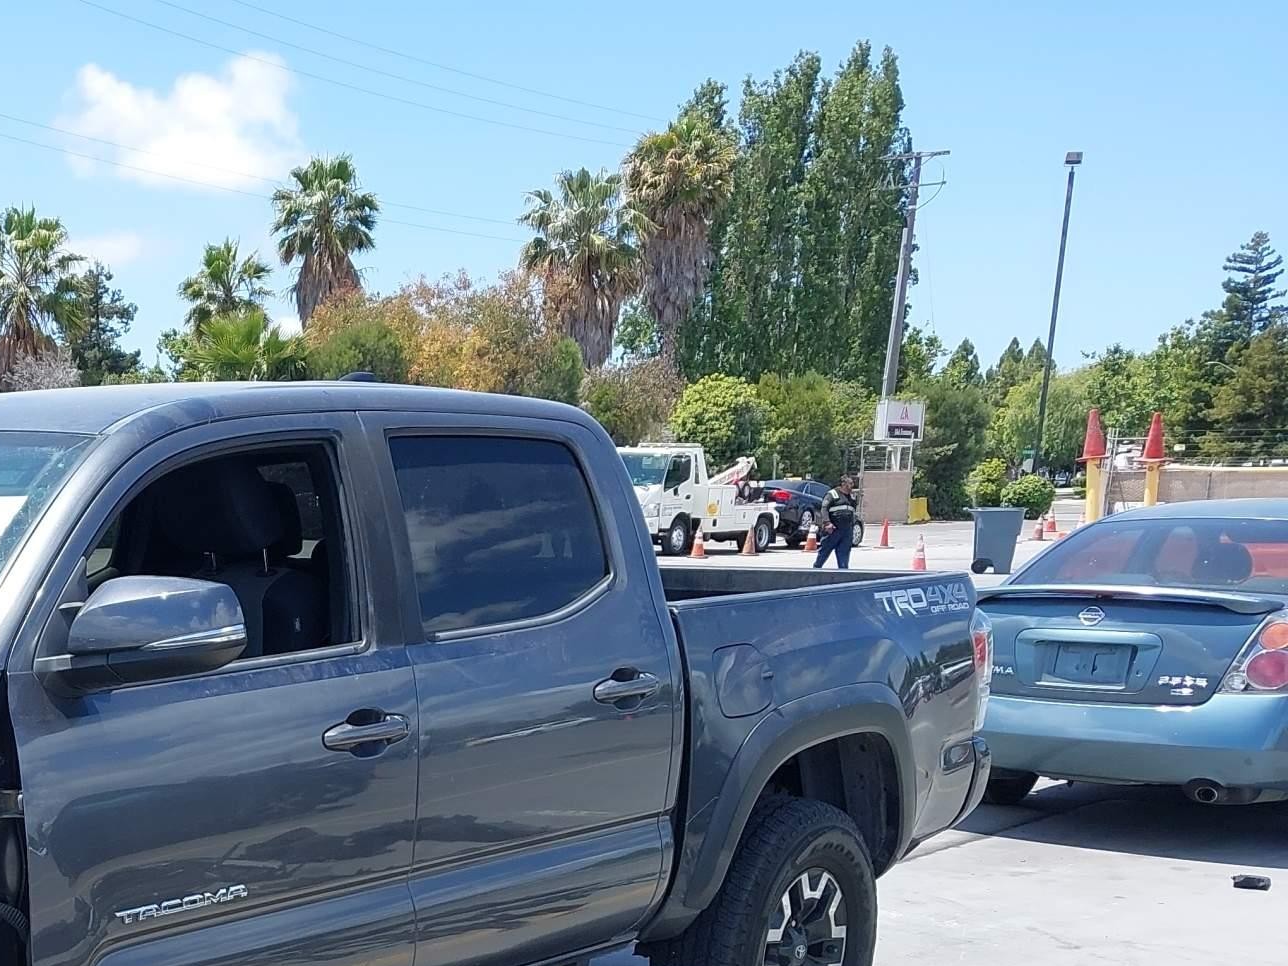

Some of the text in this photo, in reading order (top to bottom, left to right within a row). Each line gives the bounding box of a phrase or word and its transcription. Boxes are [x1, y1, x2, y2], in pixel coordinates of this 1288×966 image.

[874, 588, 927, 617] TRD
[930, 602, 970, 613] OFF ROAD
[114, 884, 248, 924] TACOMA
